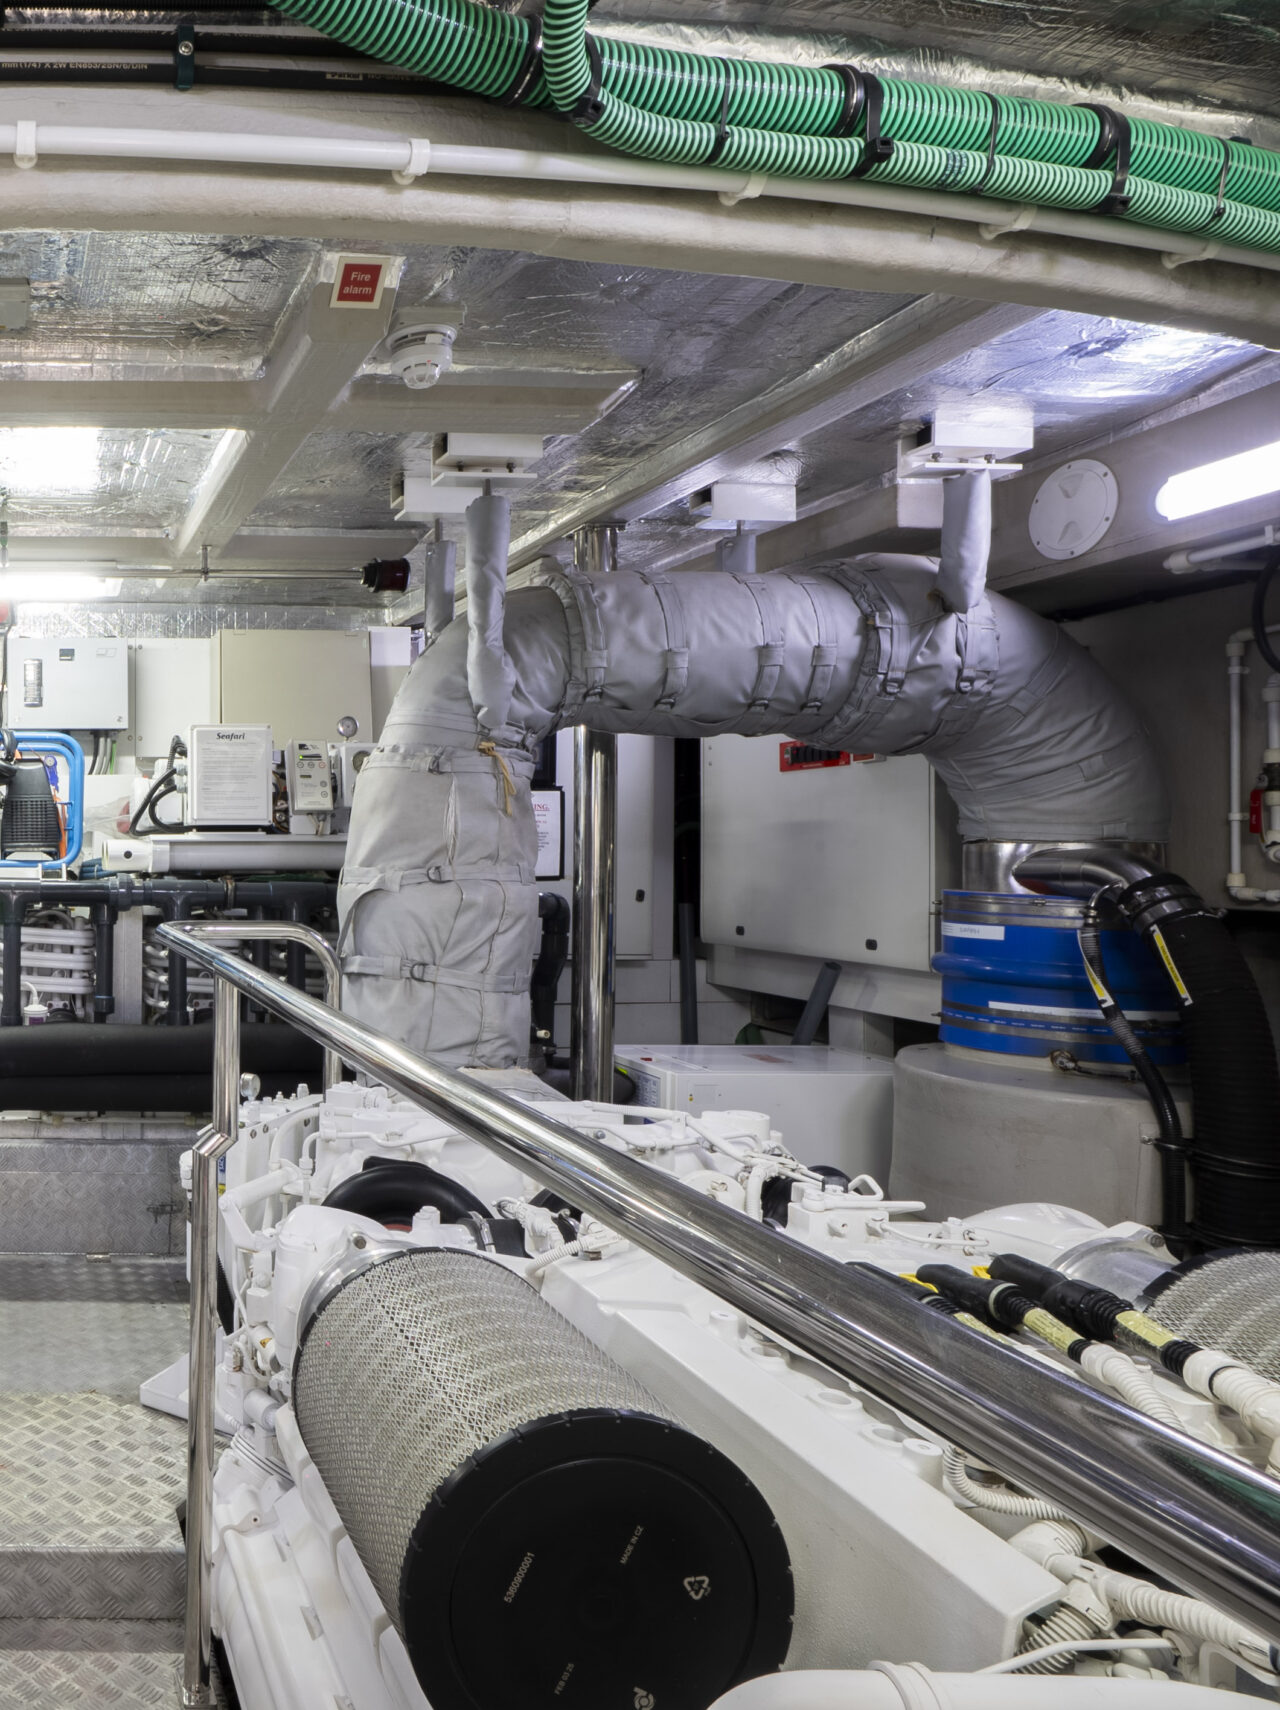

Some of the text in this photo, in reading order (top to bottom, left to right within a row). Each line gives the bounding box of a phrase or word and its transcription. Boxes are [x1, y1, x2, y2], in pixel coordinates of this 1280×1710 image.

[351, 271, 371, 282] Fire
[343, 285, 372, 294] alarm
[216, 732, 245, 741] Seafari
[620, 1525, 643, 1564] MADE IN CZ
[504, 1552, 535, 1603] 5360900001
[554, 1681, 565, 1694] FEB
